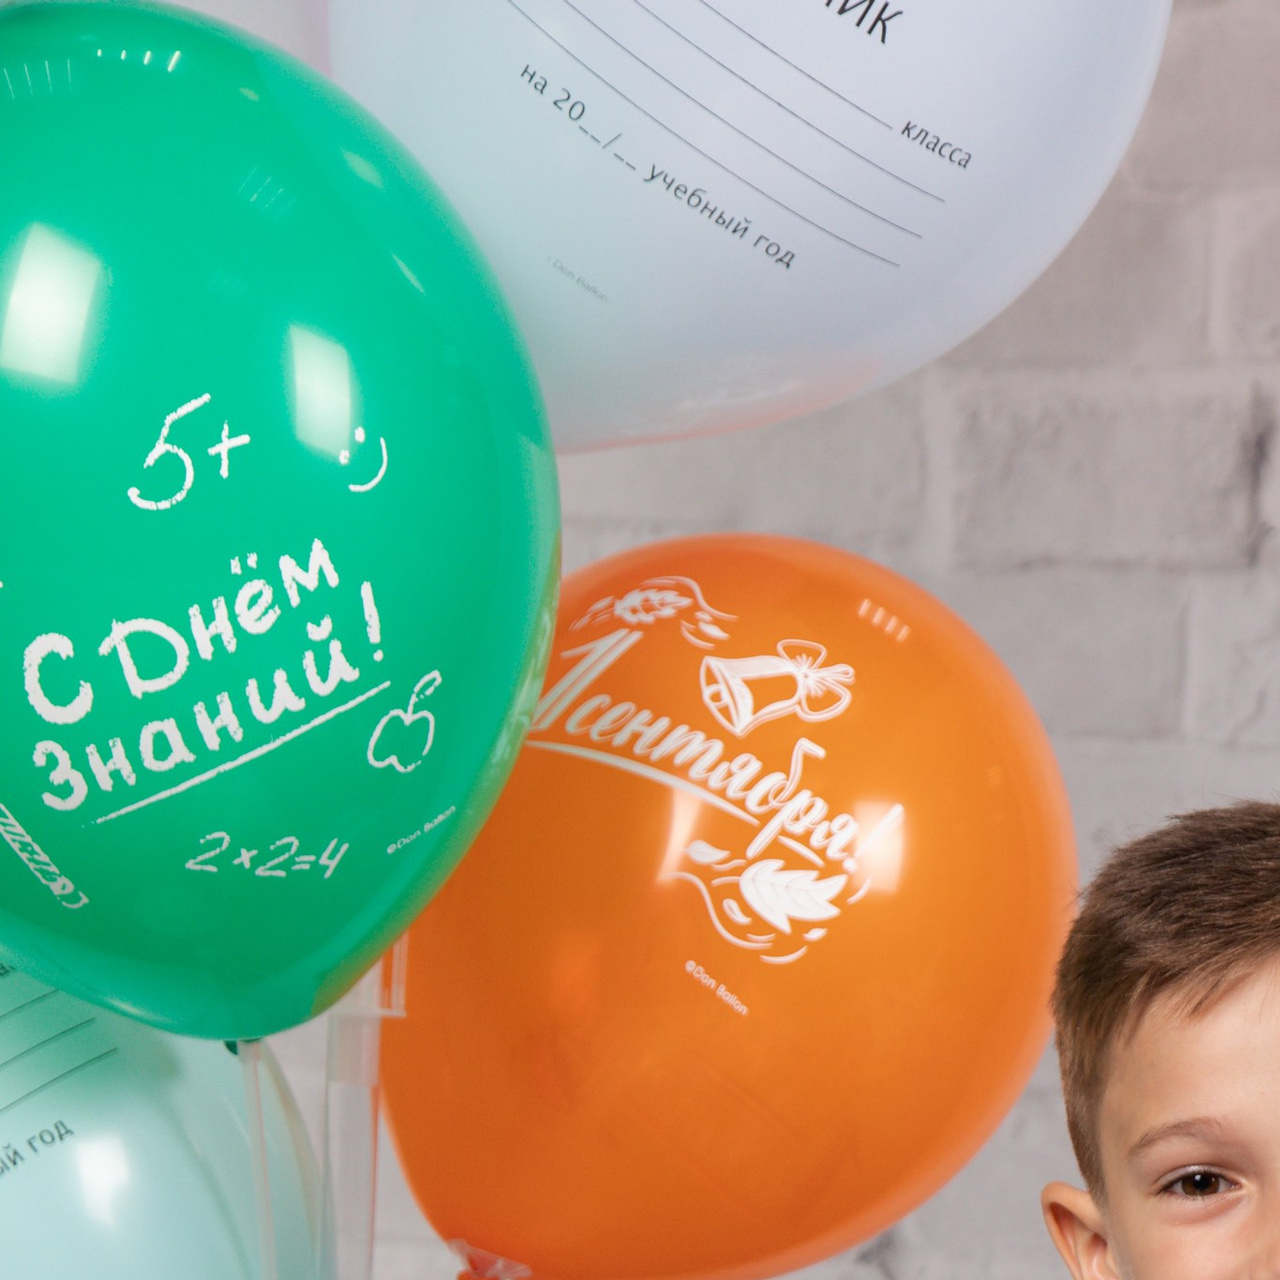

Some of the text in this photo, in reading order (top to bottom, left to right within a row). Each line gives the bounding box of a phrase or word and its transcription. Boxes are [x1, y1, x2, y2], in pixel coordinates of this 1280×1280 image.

[825, 0, 904, 44] ИК
[520, 64, 548, 95] на
[643, 163, 752, 239] учебный
[753, 234, 796, 269] год
[901, 121, 972, 168] класса
[127, 393, 251, 511] 5+
[23, 632, 94, 725] С
[716, 984, 748, 1016] Ballon
[26, 1120, 75, 1154] год
